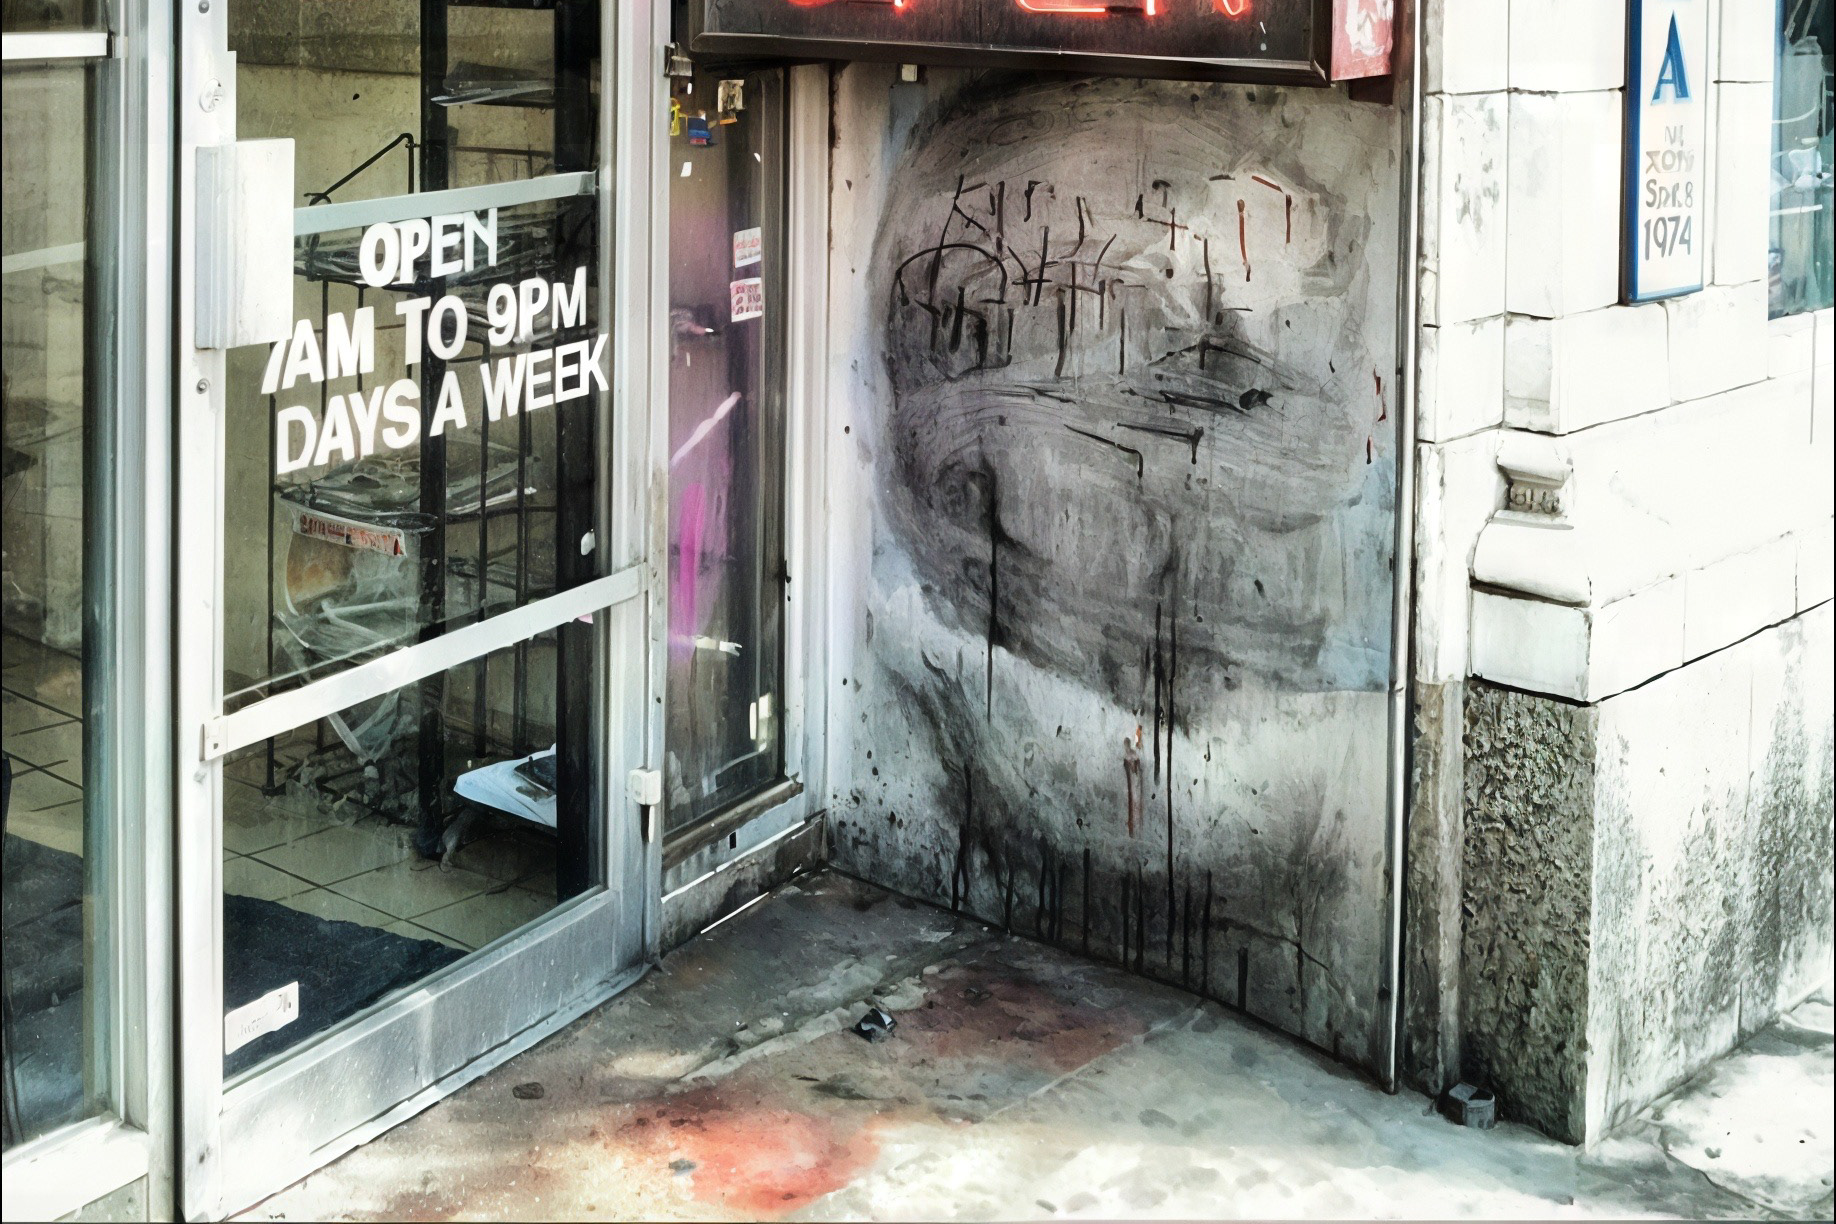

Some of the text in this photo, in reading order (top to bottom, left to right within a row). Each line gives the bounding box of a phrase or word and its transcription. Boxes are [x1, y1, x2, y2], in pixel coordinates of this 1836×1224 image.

[359, 207, 498, 287] OPEN
[1644, 215, 1692, 261] 1974
[396, 294, 467, 365] TO
[487, 266, 587, 346] 9PM
[277, 333, 610, 475] DAYS A WEEK
